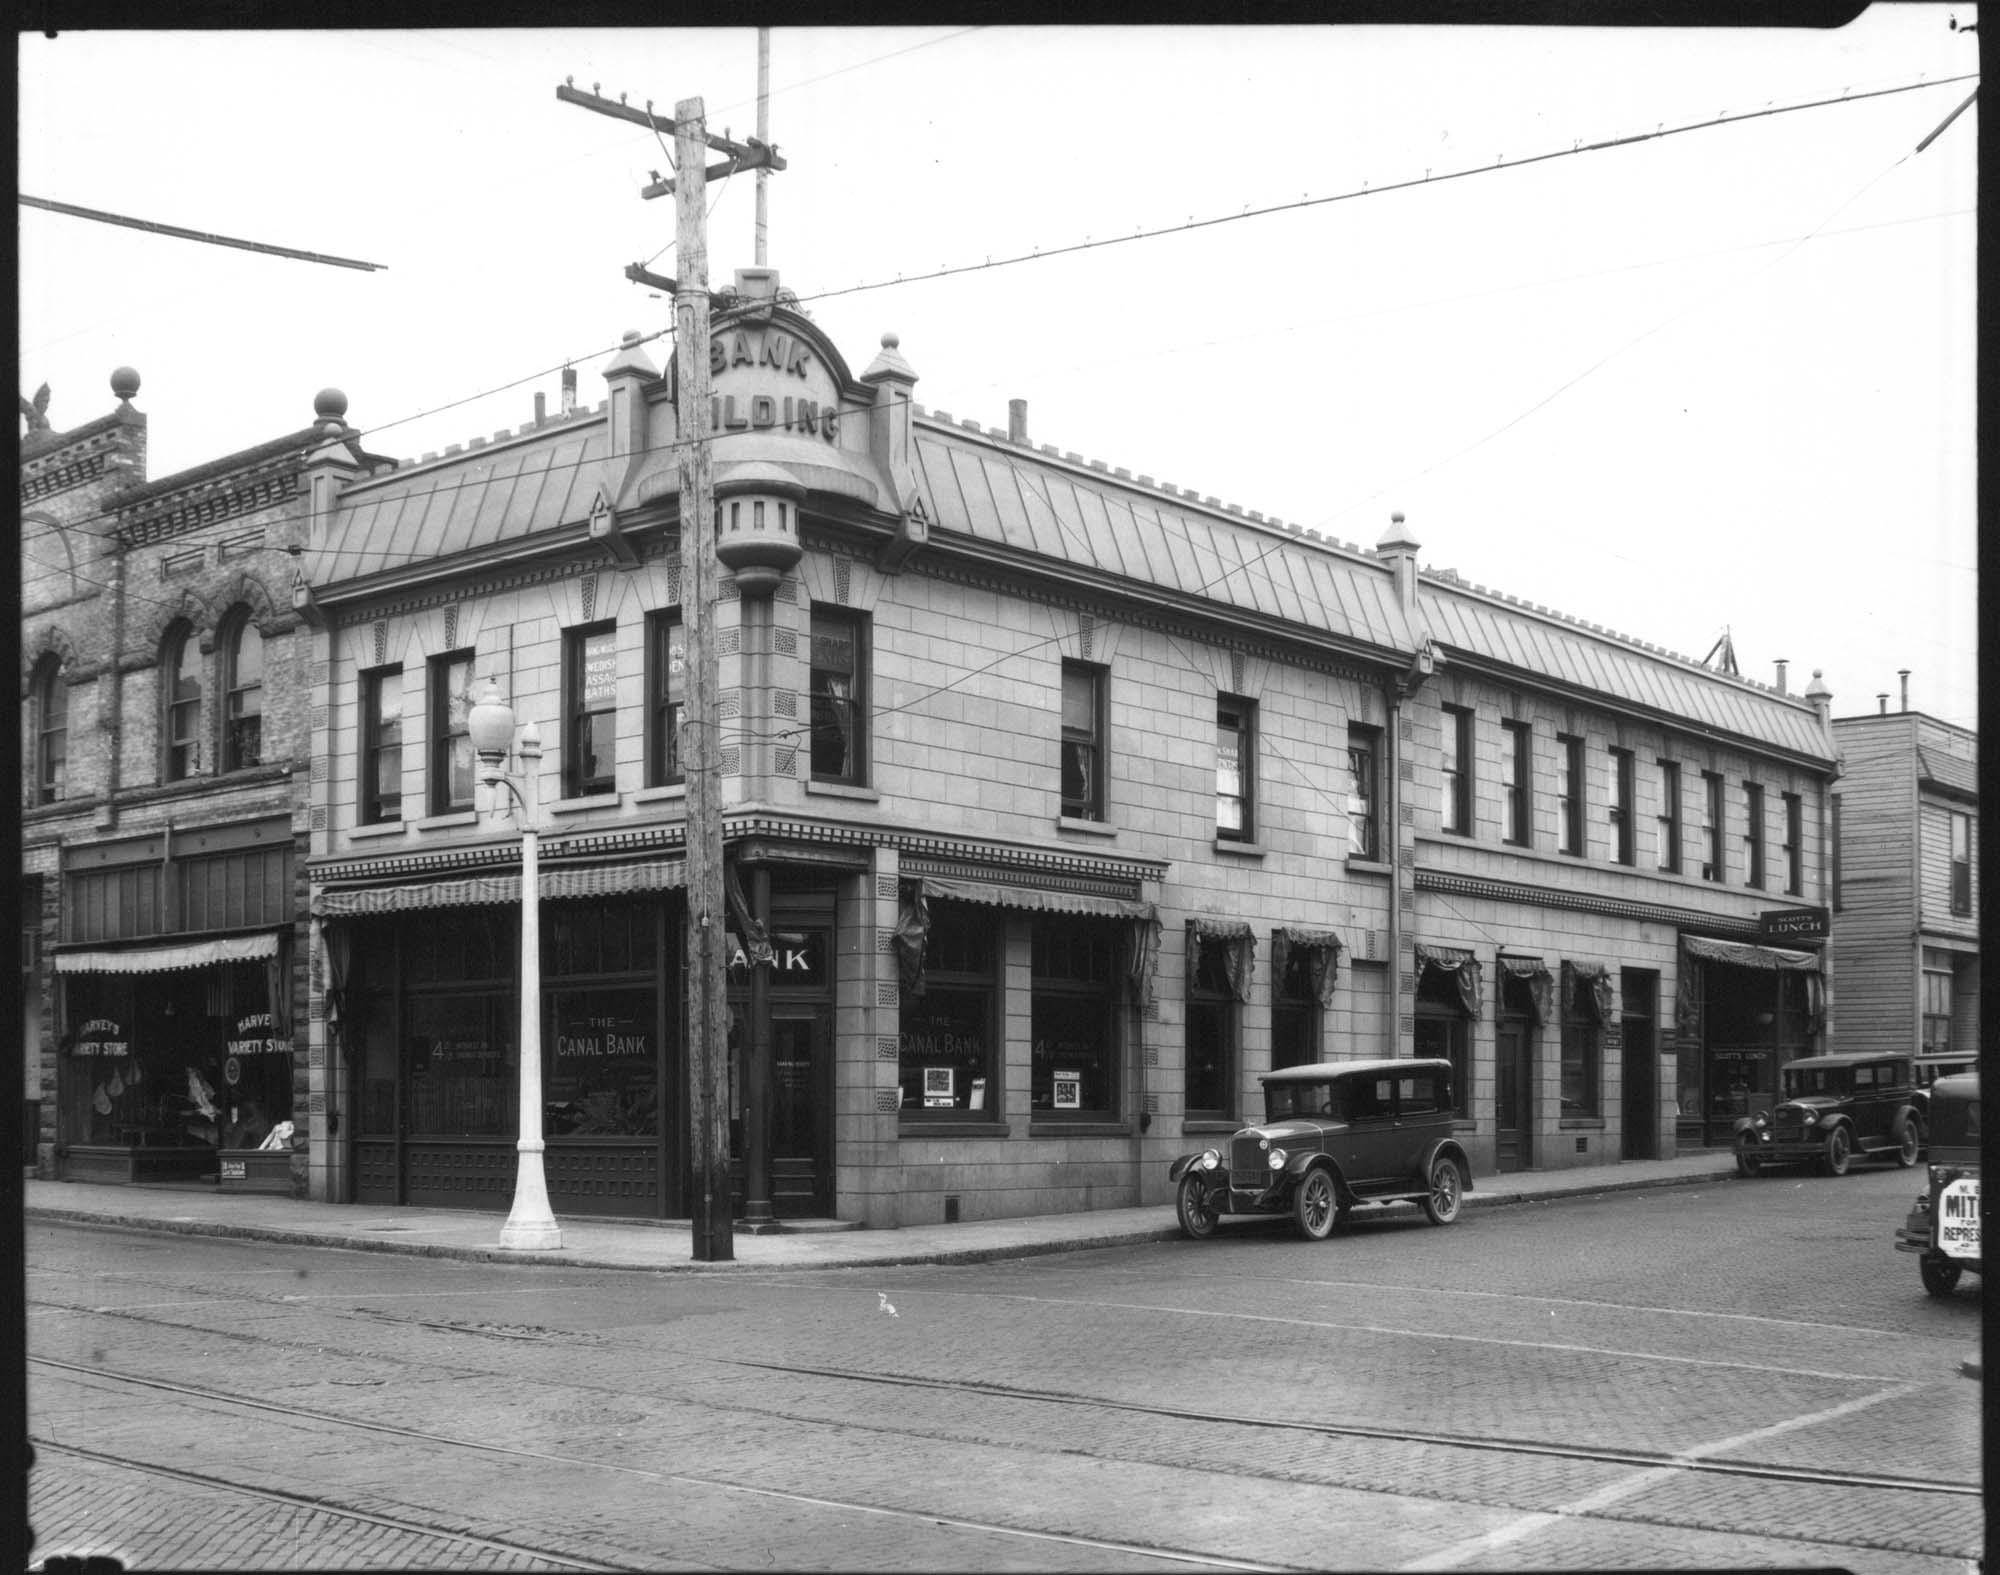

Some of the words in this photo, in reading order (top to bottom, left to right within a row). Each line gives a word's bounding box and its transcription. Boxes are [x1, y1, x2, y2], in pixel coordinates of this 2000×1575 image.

[710, 331, 810, 379] BANK
[711, 395, 839, 442] ILDING
[1769, 921, 1821, 933] LUNCH
[588, 1017, 616, 1028] THE
[928, 1016, 952, 1026] THE
[103, 1042, 129, 1056] STORE
[228, 1040, 263, 1055] VARIETY
[558, 1035, 603, 1057] CANAL
[606, 1033, 646, 1056] BANK
[900, 1032, 943, 1057] CANAL
[944, 1033, 981, 1057] BANK
[1945, 1195, 1980, 1218] MIT
